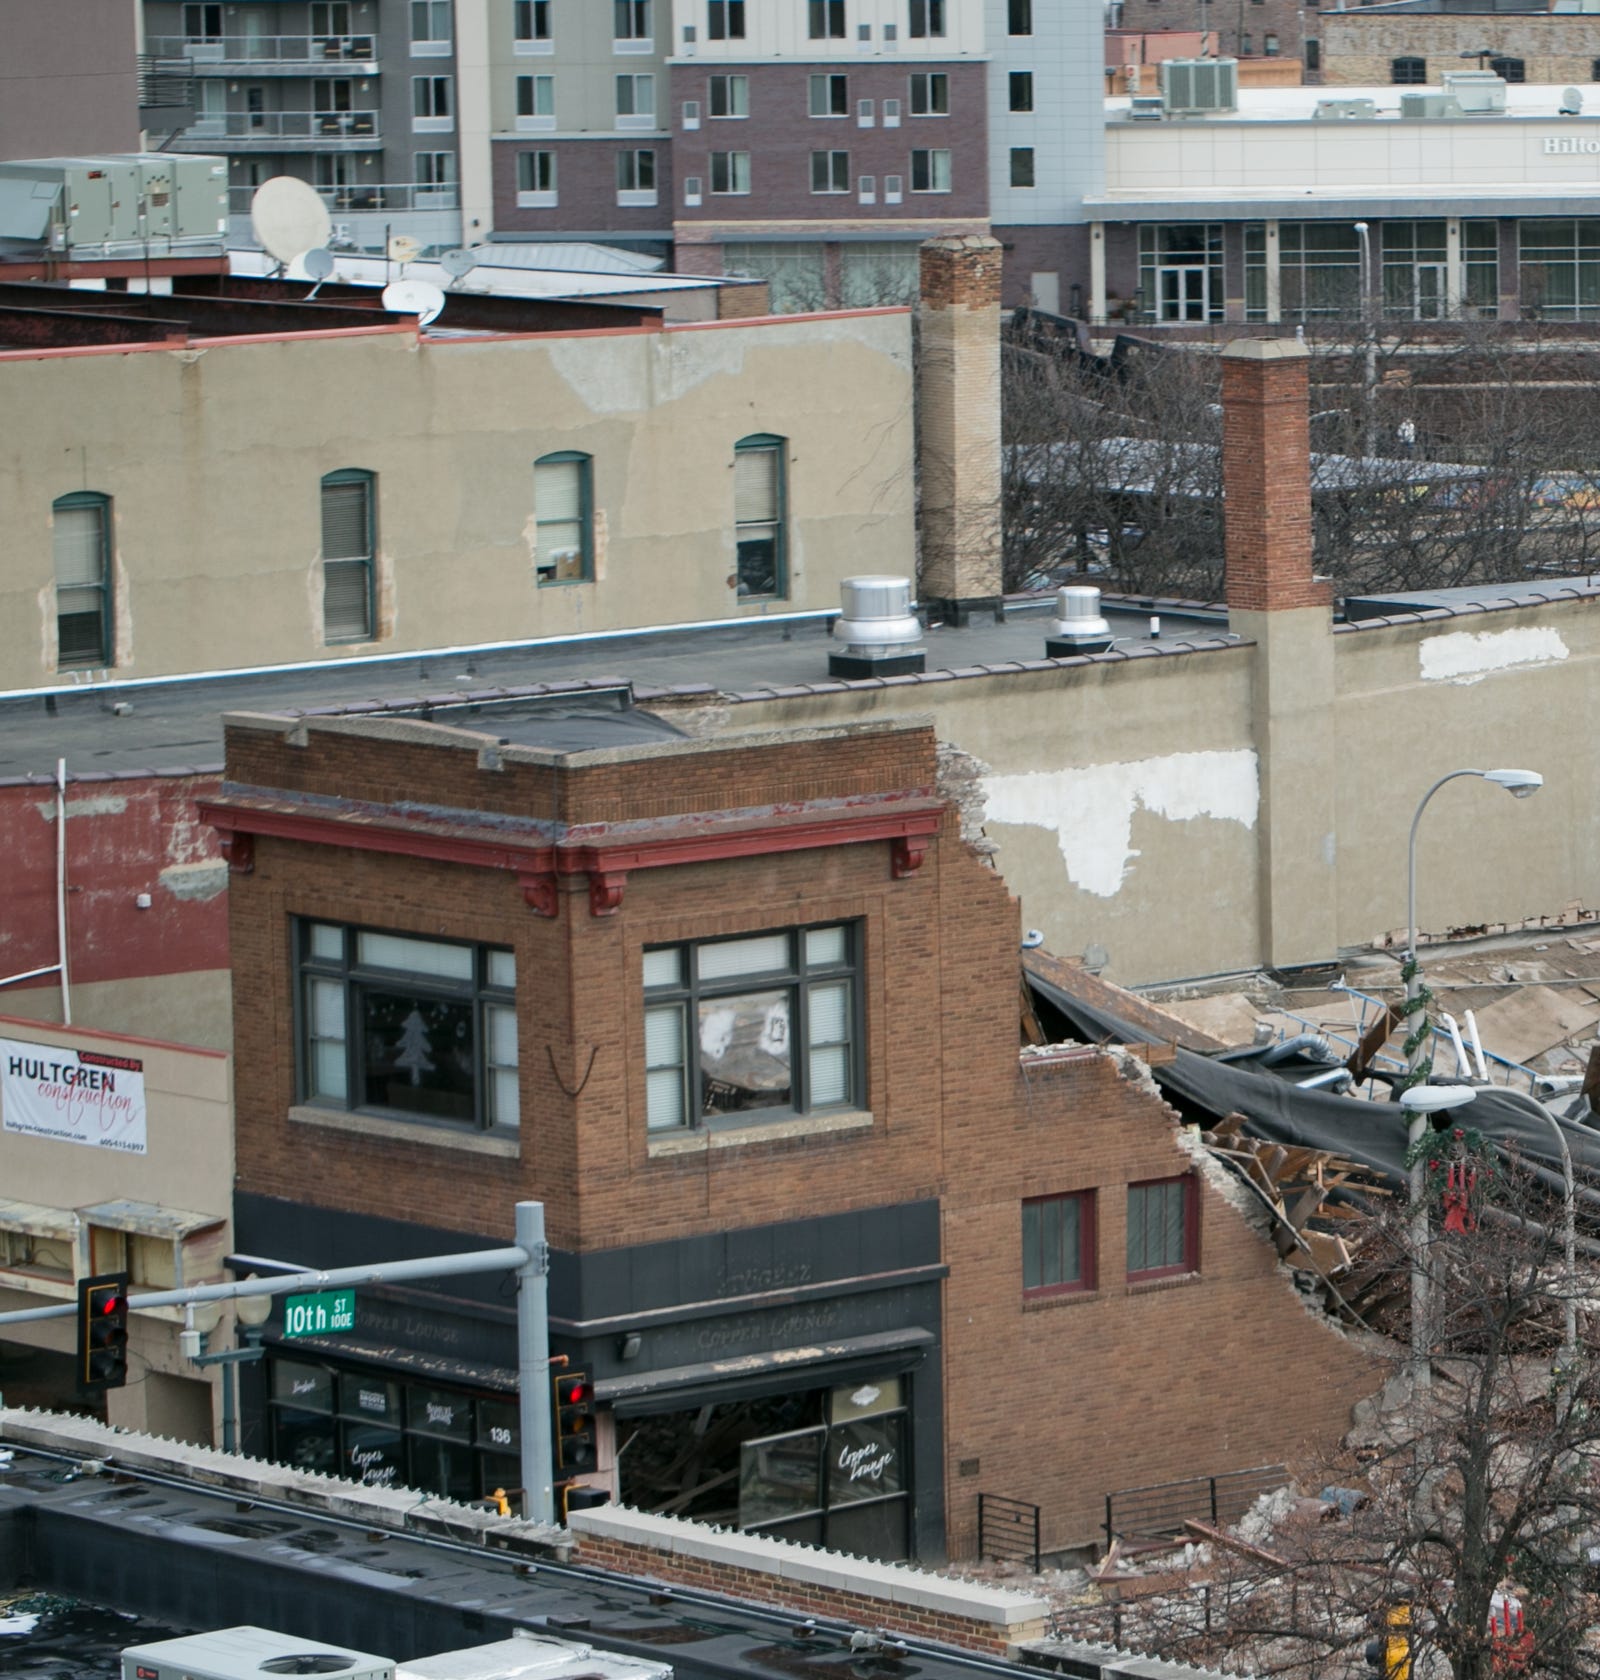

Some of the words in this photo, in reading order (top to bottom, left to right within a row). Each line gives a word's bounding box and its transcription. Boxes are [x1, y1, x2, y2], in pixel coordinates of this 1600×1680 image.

[9, 1055, 116, 1093] HULTGREN
[37, 1066, 136, 1131] construction
[286, 1304, 327, 1334] 10th
[334, 1298, 347, 1313] ST
[330, 1312, 353, 1328] 100E
[490, 1426, 512, 1445] 136
[351, 1444, 385, 1468] Copper
[838, 1443, 879, 1470] Copper
[849, 1453, 894, 1482] Lounge
[362, 1463, 398, 1485] Lounge
